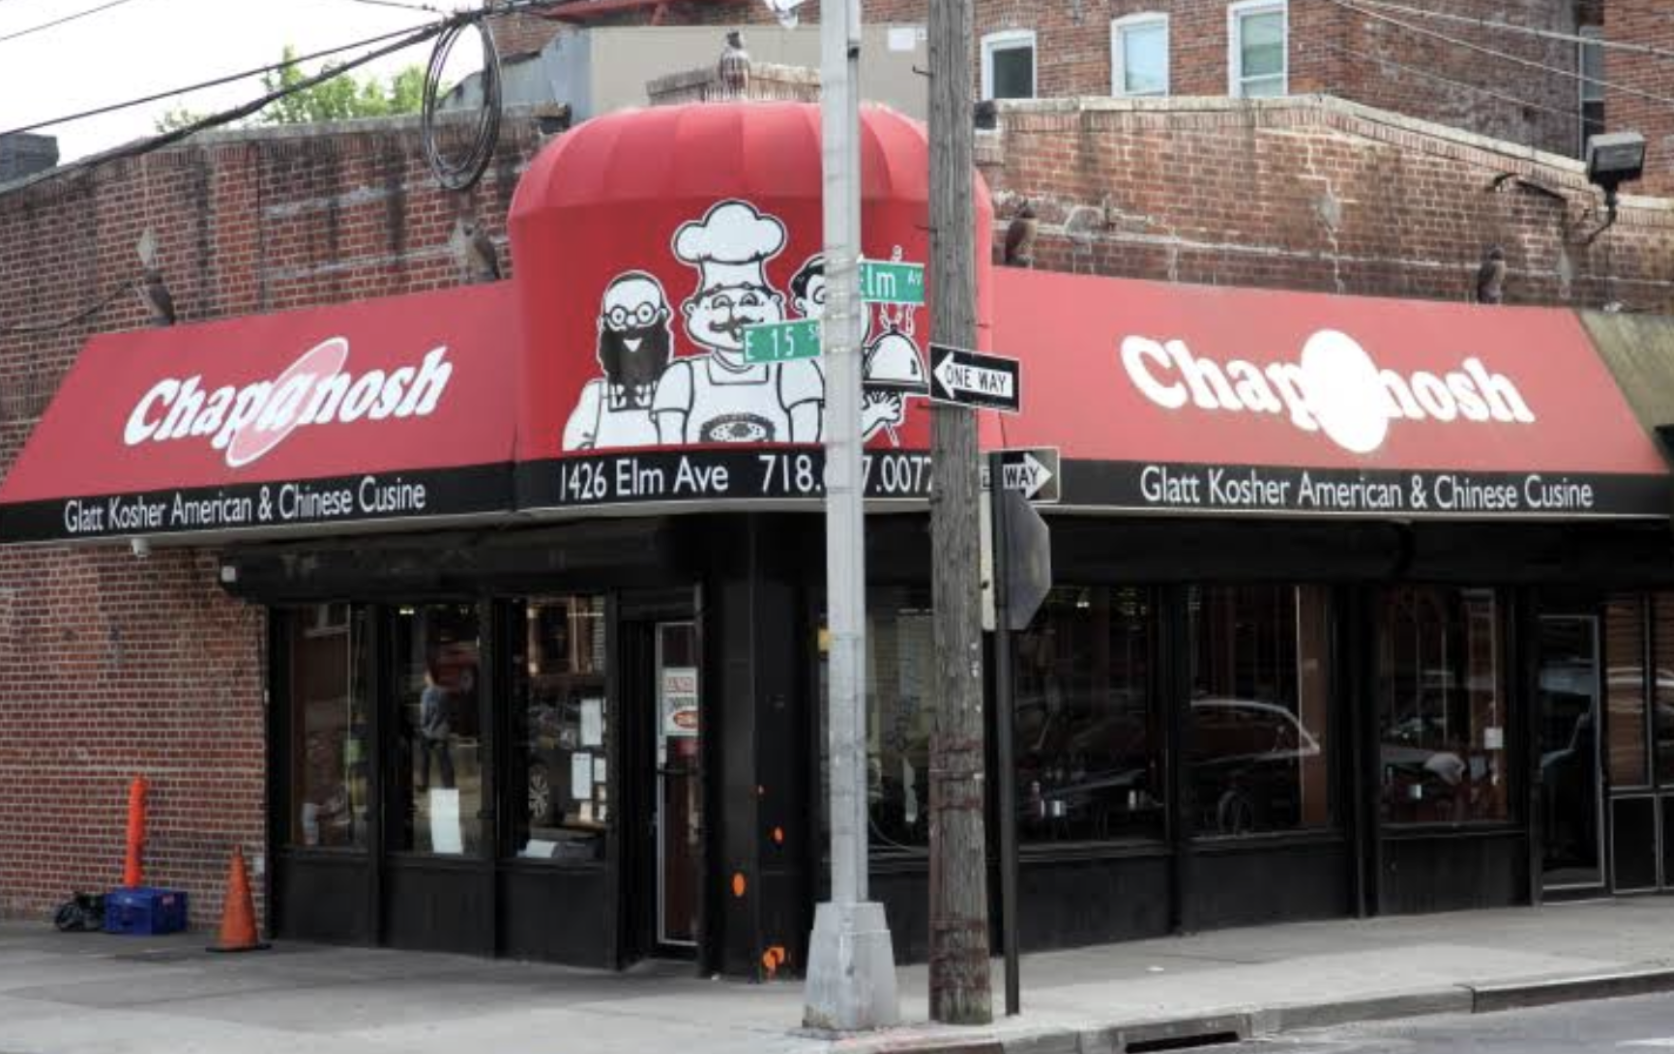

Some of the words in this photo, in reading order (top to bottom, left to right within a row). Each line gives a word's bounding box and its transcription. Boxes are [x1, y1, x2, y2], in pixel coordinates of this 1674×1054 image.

[861, 265, 896, 297] lm
[745, 331, 753, 359] E
[773, 327, 794, 357] 15
[124, 345, 453, 448] Chapanosh
[946, 365, 972, 387] ONE
[979, 372, 1007, 393] WAY
[560, 463, 607, 500] 1426
[616, 459, 663, 495] Elm
[673, 457, 729, 493] Ave
[1005, 466, 1040, 487] WAY
[1140, 465, 1200, 502] Glatt
[1209, 469, 1289, 504] Kosher
[1299, 471, 1402, 506] American
[1411, 476, 1428, 509] &
[1434, 475, 1517, 509] Chinese
[1525, 475, 1593, 508] Cusine
[65, 499, 103, 533] Glatt
[109, 493, 166, 528] Kosher
[170, 484, 252, 524] American
[258, 485, 273, 519] &
[279, 478, 353, 517] Chinese
[359, 475, 426, 512] Cusine
